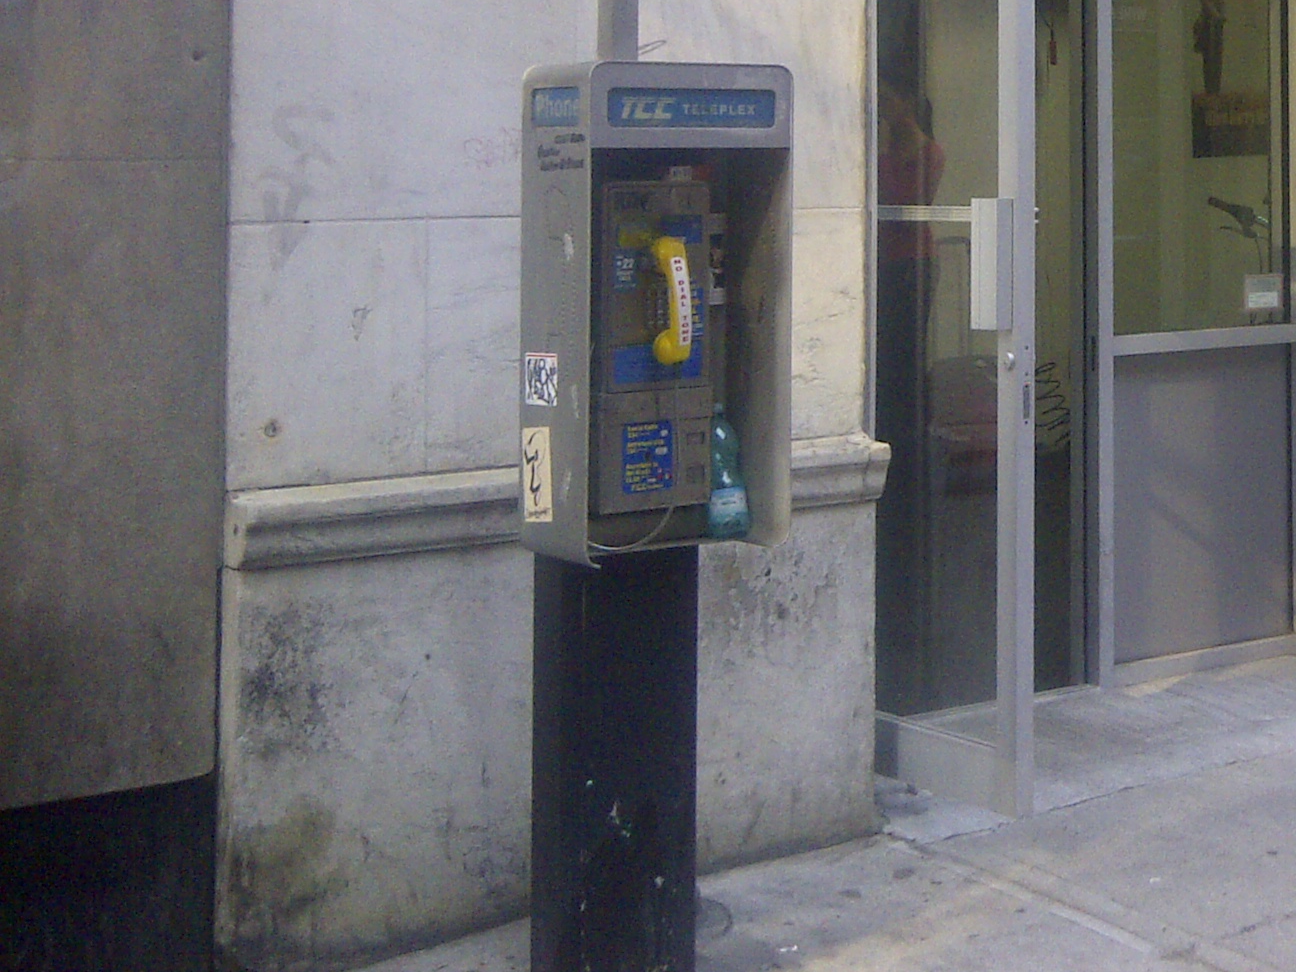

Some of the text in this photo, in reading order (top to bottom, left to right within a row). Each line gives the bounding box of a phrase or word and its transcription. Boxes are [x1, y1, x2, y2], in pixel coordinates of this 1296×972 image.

[683, 103, 757, 116] TELEPLEX
[674, 259, 690, 343] NO DIAL TONE
